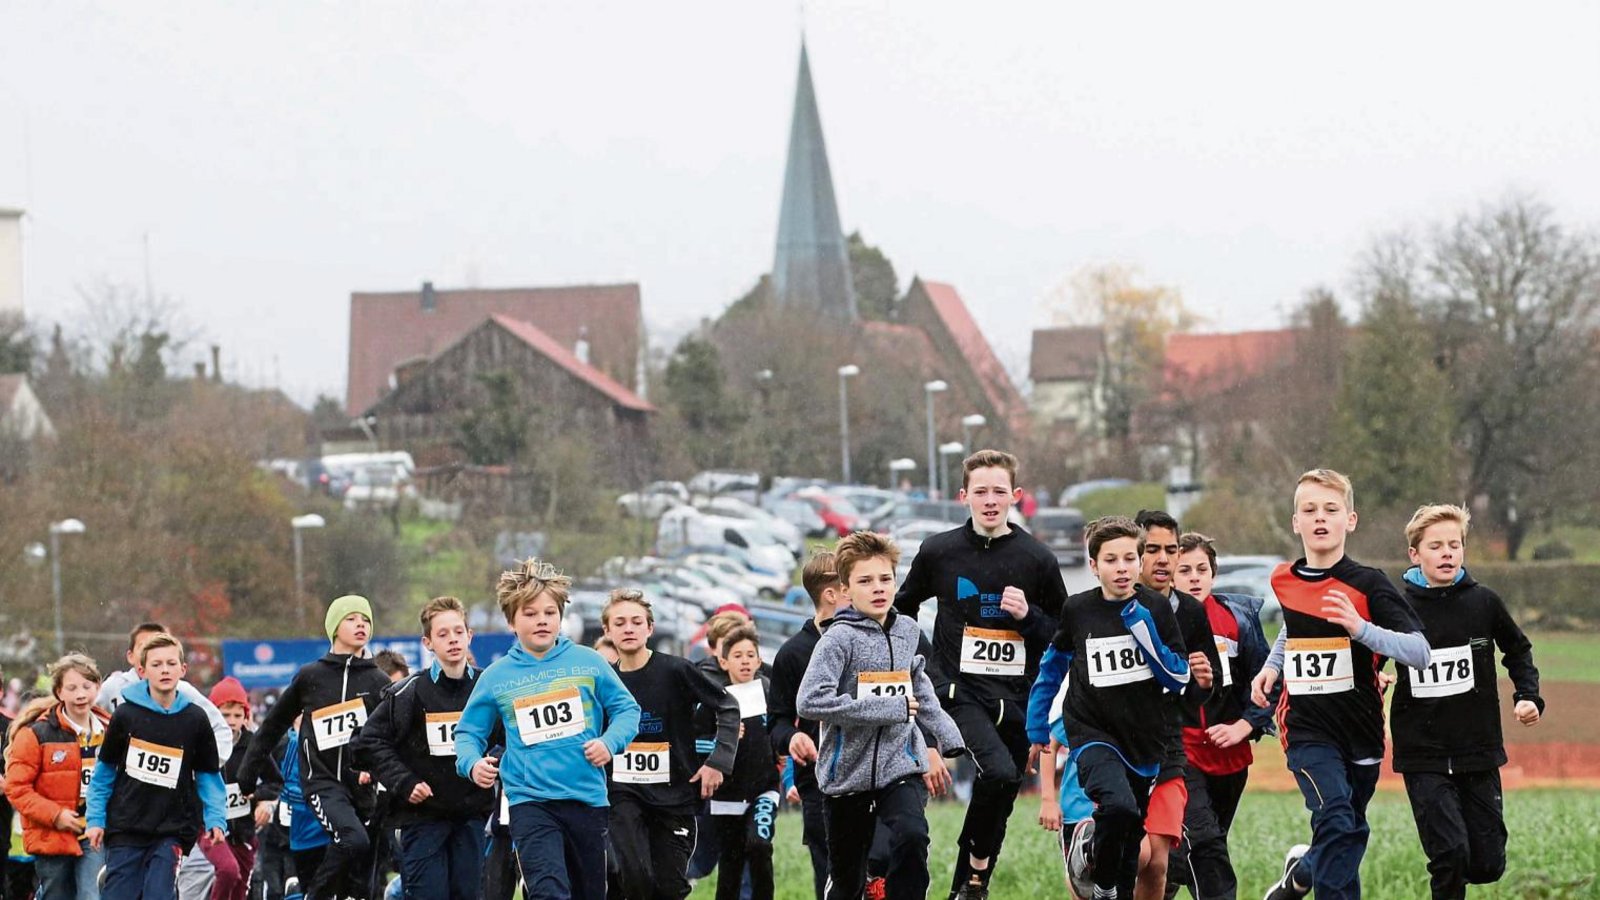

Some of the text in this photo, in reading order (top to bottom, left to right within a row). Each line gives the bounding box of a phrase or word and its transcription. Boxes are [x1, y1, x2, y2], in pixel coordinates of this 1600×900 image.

[973, 640, 1015, 662] 209
[1092, 647, 1148, 672] 1180
[1292, 653, 1337, 677] 137
[1414, 658, 1470, 683] 1178
[492, 667, 567, 694] DYNAMICS
[322, 711, 359, 736] 773
[529, 702, 573, 729] 103
[137, 752, 171, 774] 195
[624, 752, 660, 771] 190
[226, 792, 249, 808] 23
